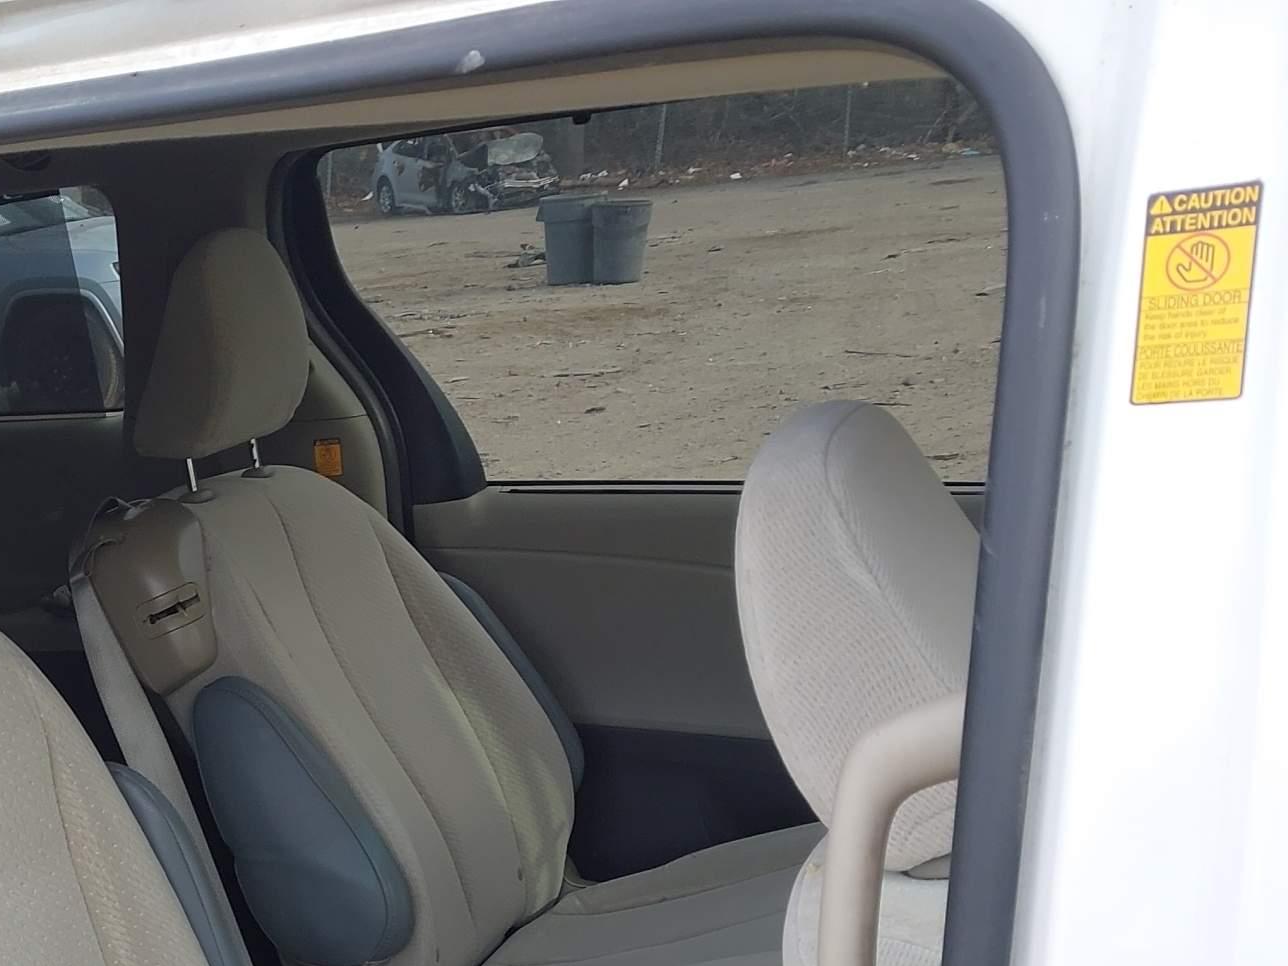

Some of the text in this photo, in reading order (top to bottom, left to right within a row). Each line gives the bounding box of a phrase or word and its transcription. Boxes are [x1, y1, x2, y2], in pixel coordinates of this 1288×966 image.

[1173, 185, 1259, 211] CAUTION
[1151, 206, 1257, 234] ATTENTION
[1148, 291, 1242, 310] SLIDING DOOR
[1174, 341, 1244, 358] COULISSANTE
